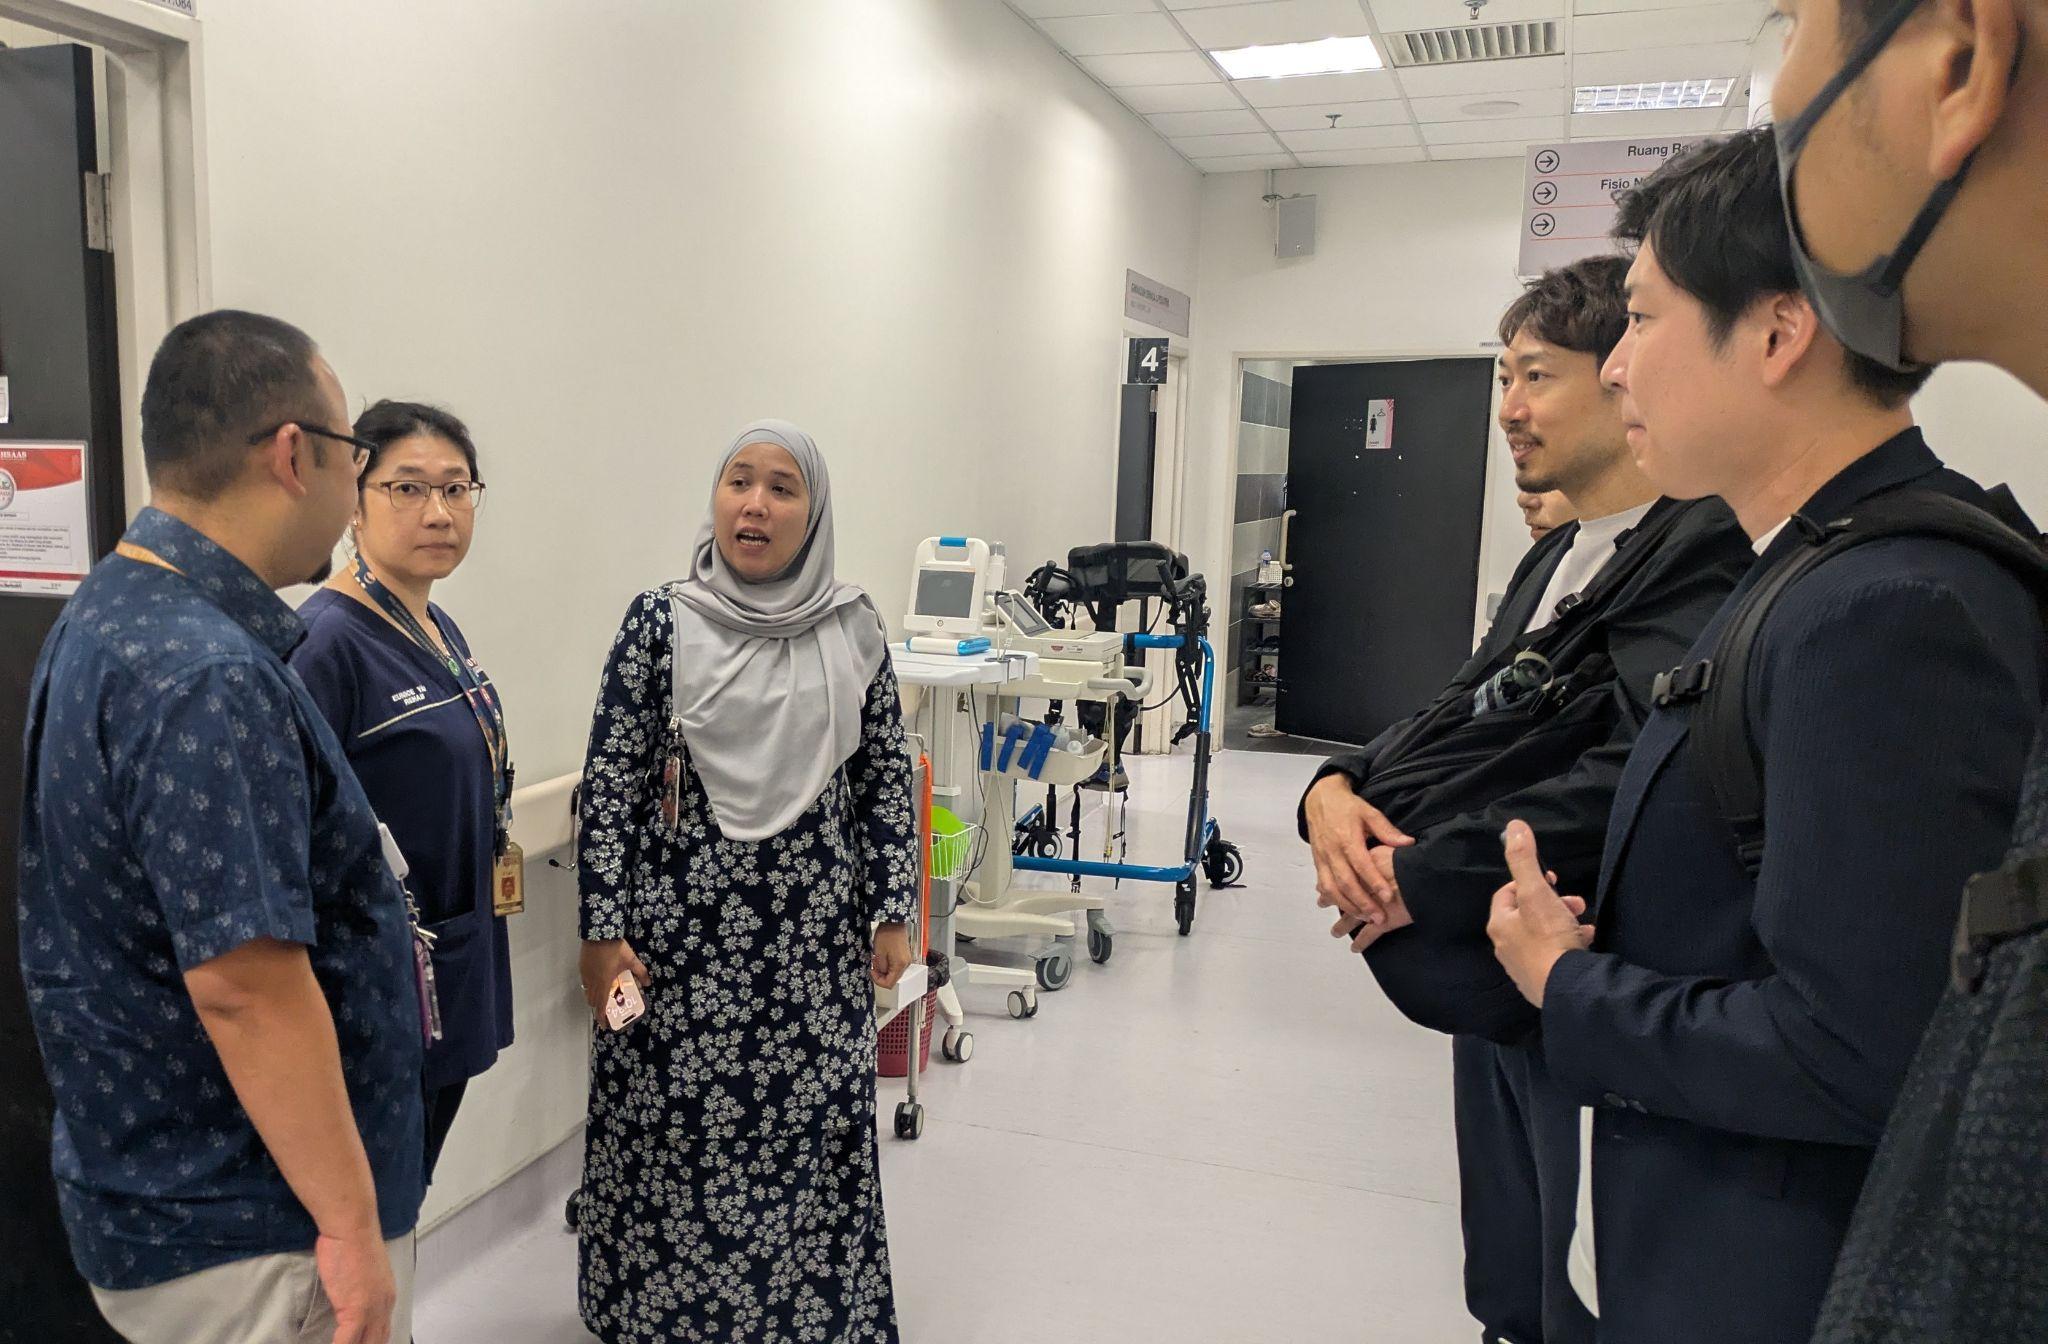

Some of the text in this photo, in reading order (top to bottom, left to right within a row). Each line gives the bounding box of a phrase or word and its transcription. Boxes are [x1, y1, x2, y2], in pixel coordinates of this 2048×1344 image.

[1628, 145, 1668, 157] Ruang
[1600, 179, 1630, 190] Fisio
[1141, 346, 1159, 372] 4
